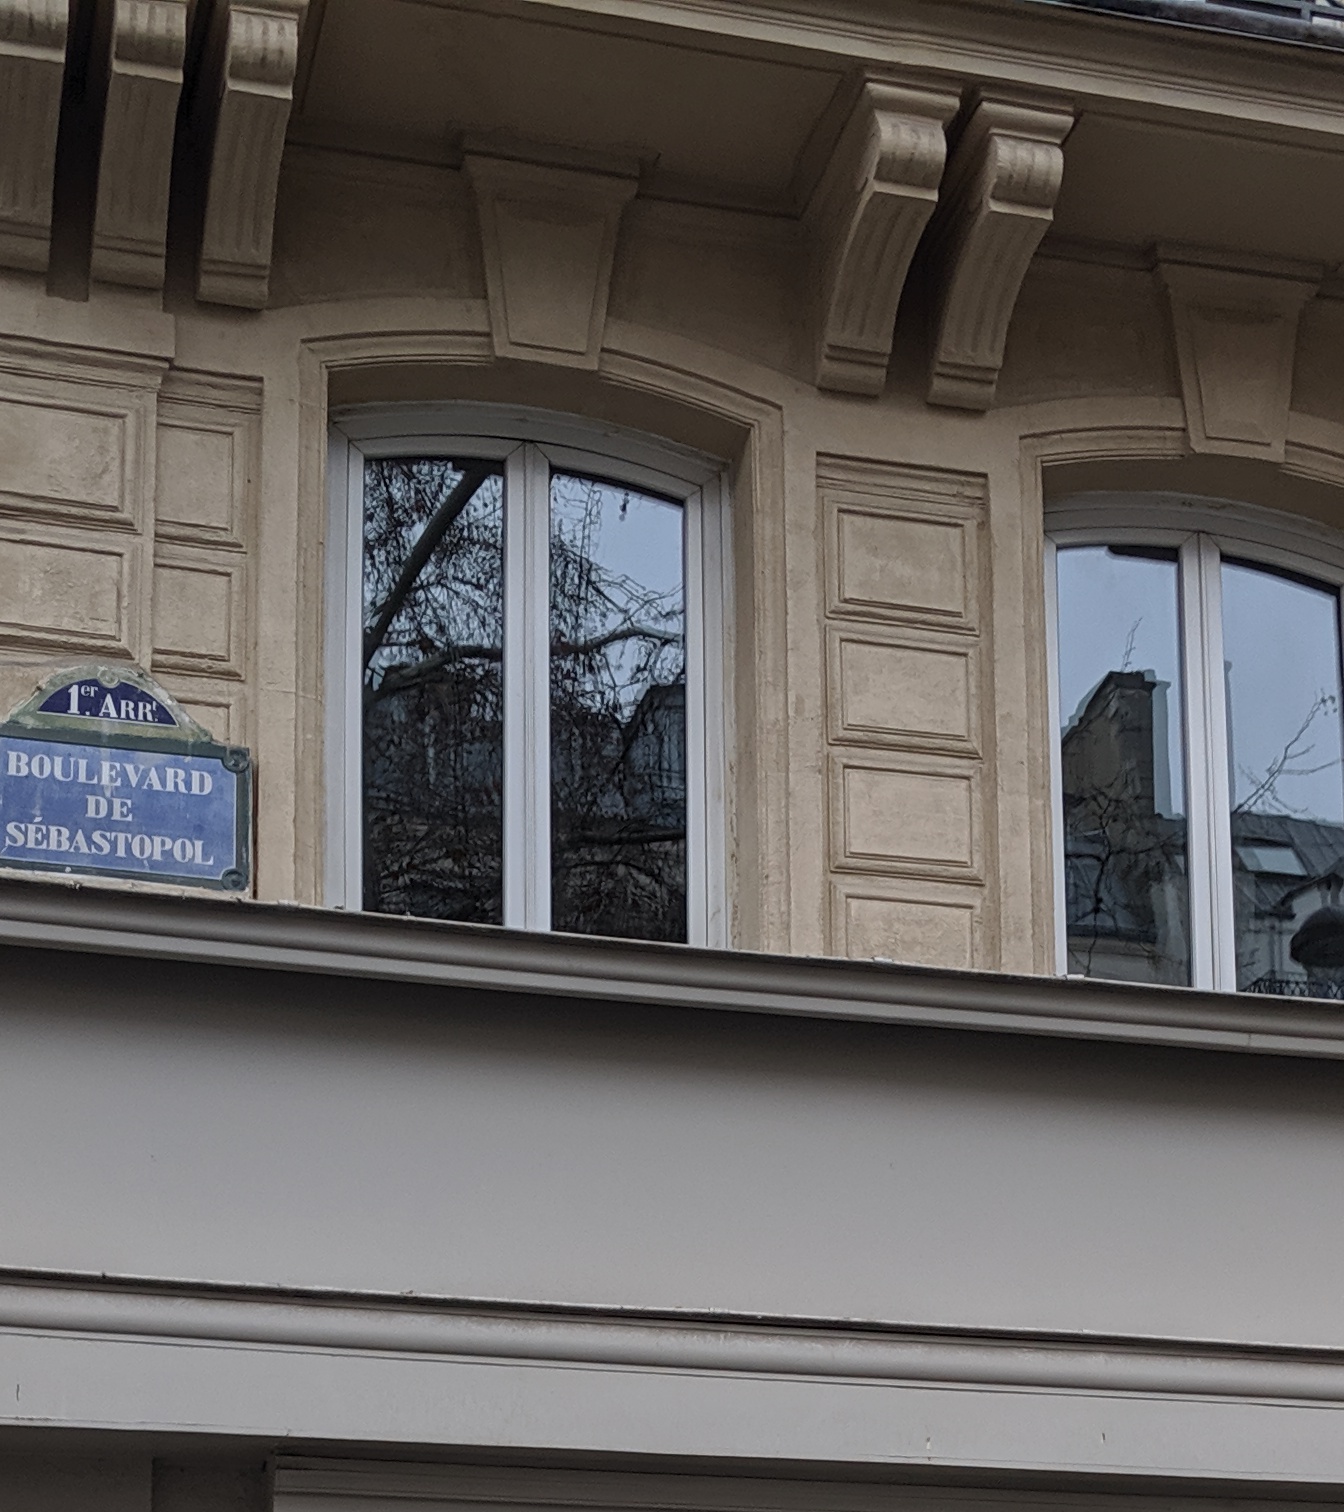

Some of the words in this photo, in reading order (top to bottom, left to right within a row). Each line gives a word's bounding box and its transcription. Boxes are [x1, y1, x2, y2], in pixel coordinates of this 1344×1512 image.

[6, 751, 213, 796] BOULEVARD
[85, 795, 133, 821] DE
[6, 817, 214, 865] SÉBASTOPOL
